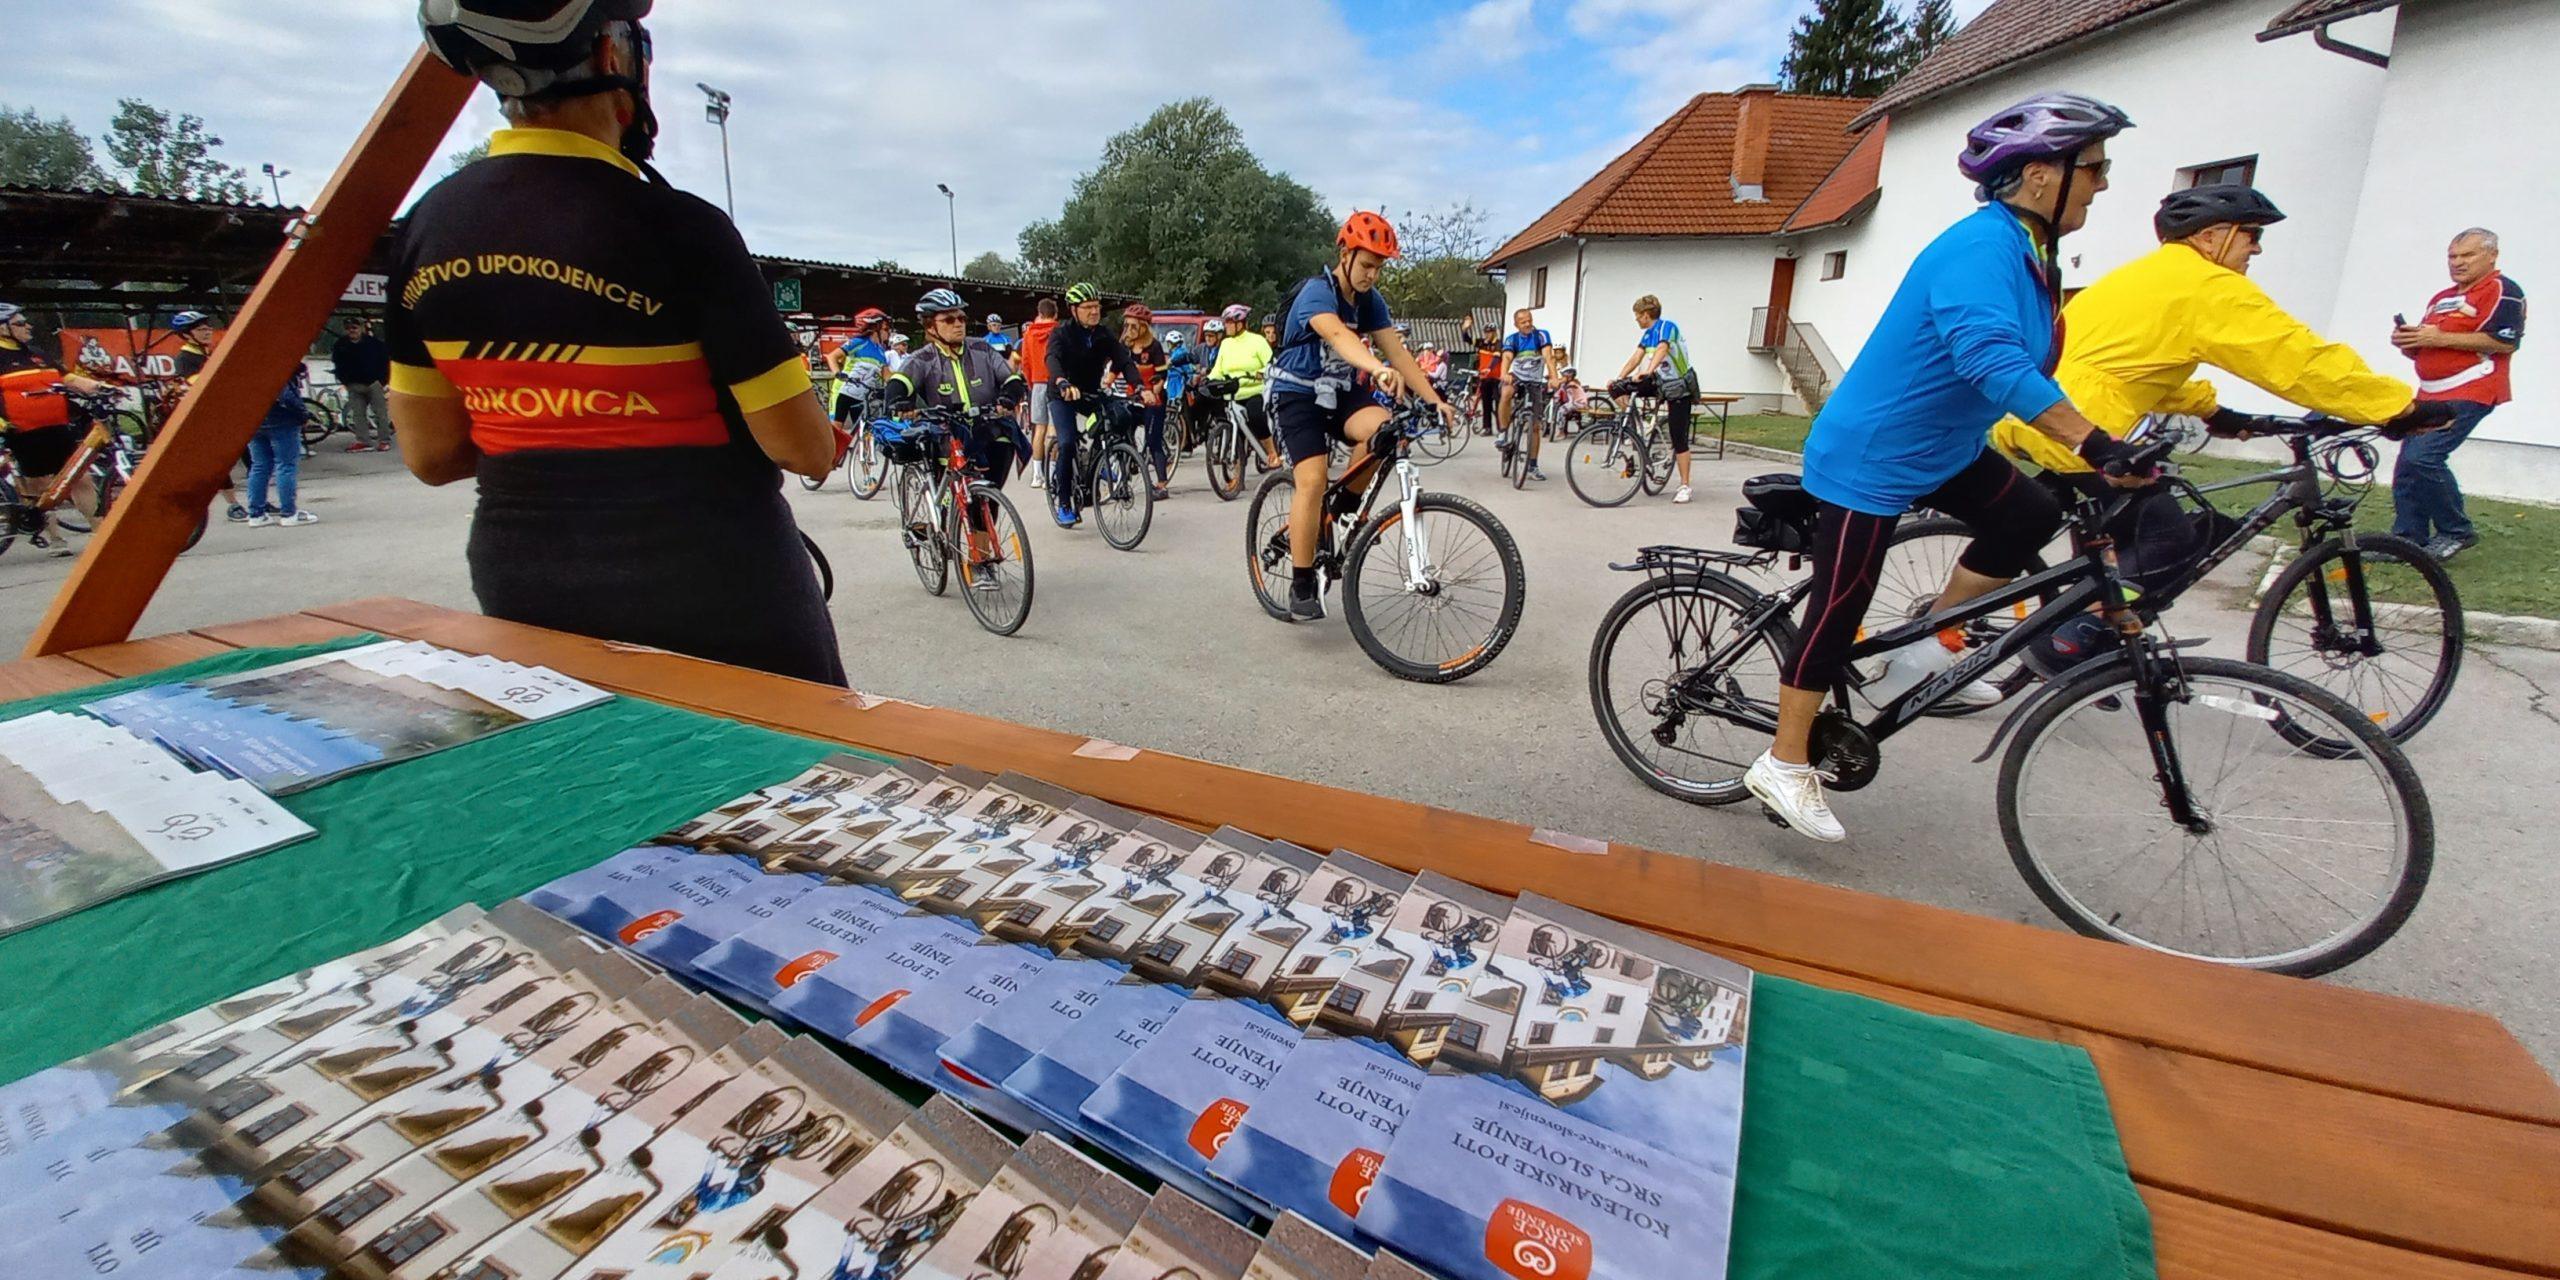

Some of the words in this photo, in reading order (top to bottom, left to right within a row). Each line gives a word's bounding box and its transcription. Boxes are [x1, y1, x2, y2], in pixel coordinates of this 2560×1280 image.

[477, 254, 662, 316] UPOKOJENCEV
[1910, 647, 1993, 709] MARIN
[806, 916, 842, 936] POTI
[885, 951, 922, 974] POTI
[1191, 1046, 1239, 1077] POTI
[1314, 1090, 1369, 1123] POTI
[1336, 1075, 1411, 1118] VENIJE
[1451, 1131, 1511, 1168] POTI
[1472, 1116, 1596, 1178] SLOVENIJE
[1498, 1099, 1650, 1169] www.srce-slovenije.si
[1512, 1157, 1671, 1240] KOLESARSKE
[1598, 1167, 1663, 1208] SRCA
[1506, 1203, 1585, 1248] SLOVENIJE
[1512, 1219, 1574, 1254] SRCE
